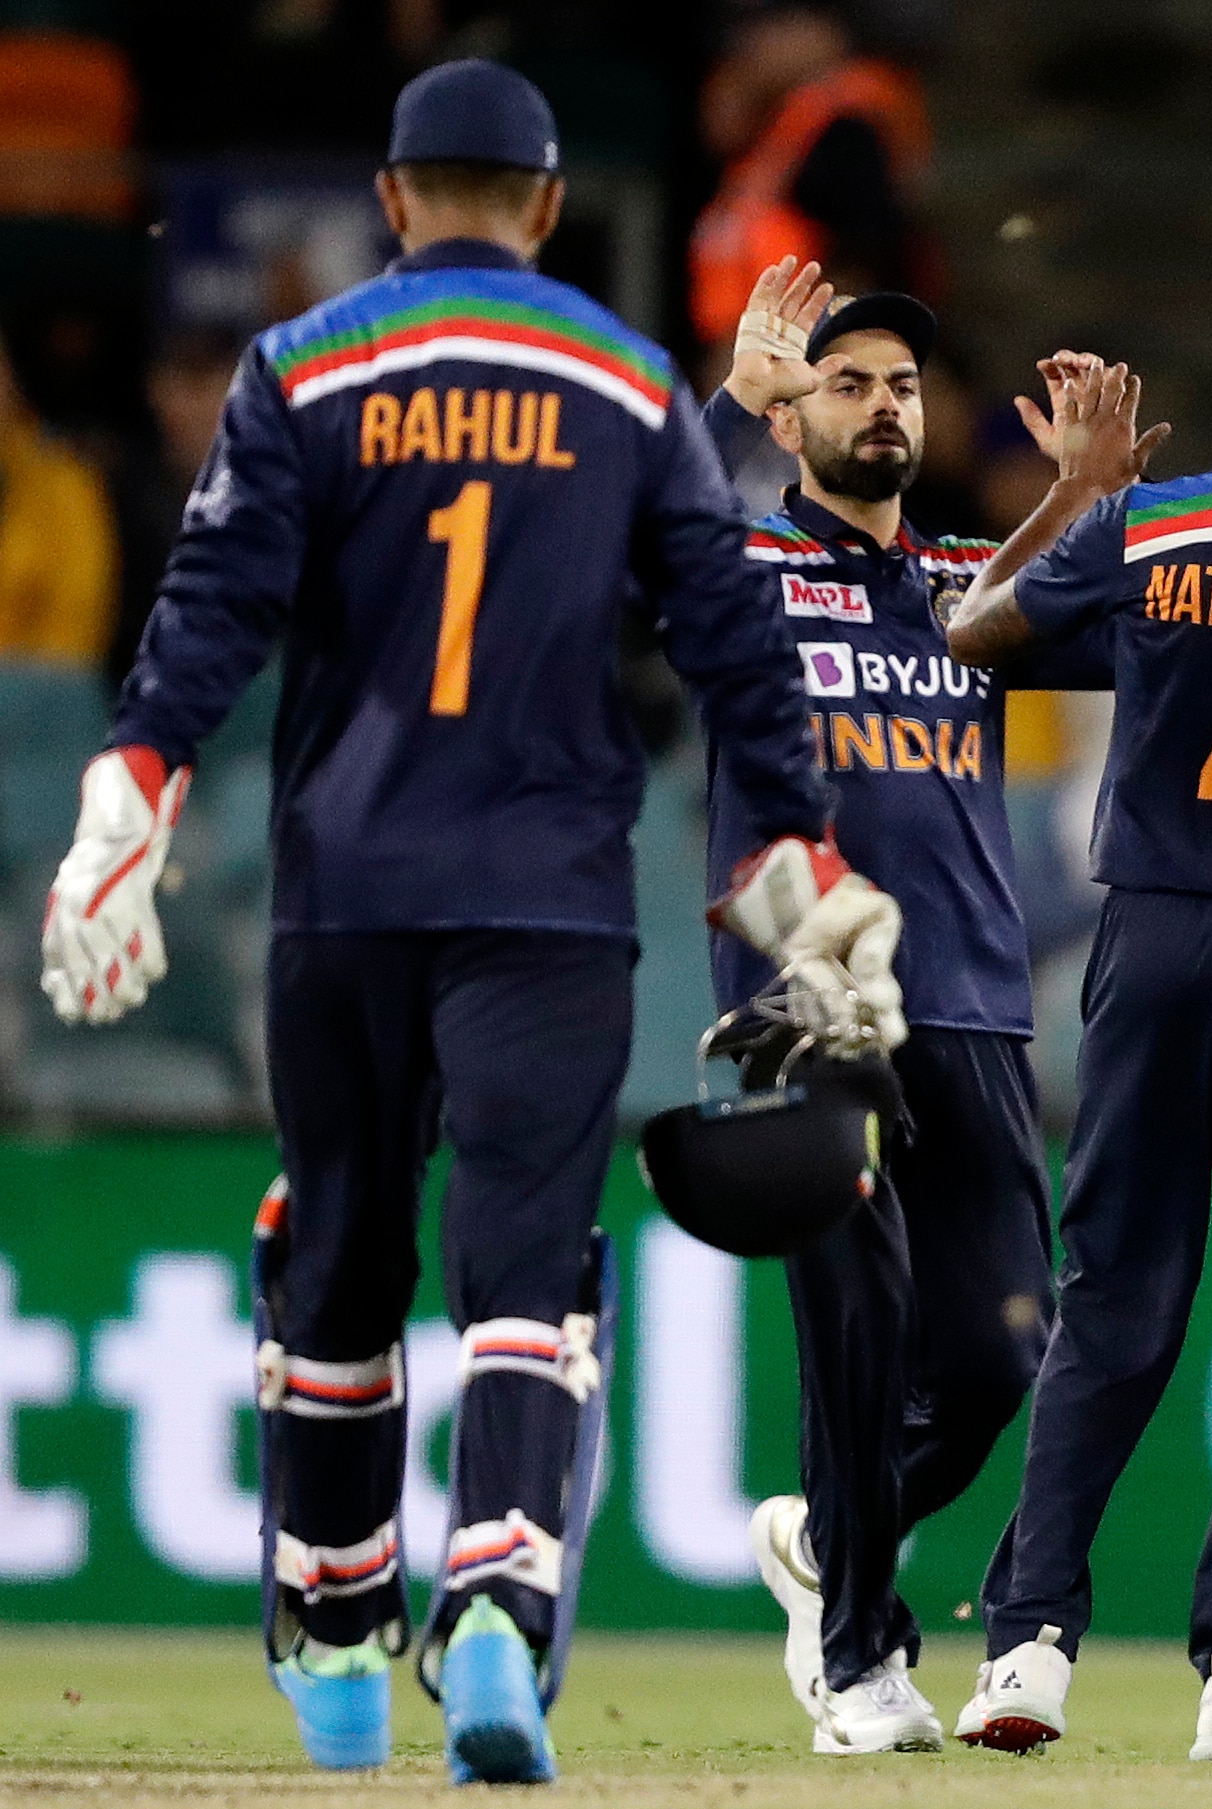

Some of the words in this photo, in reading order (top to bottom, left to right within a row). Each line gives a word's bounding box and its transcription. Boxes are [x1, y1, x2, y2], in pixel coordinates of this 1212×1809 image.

[360, 387, 575, 468] RAHUL
[428, 480, 492, 716] 1
[788, 580, 863, 610] MPL
[809, 712, 982, 783] INDIA
